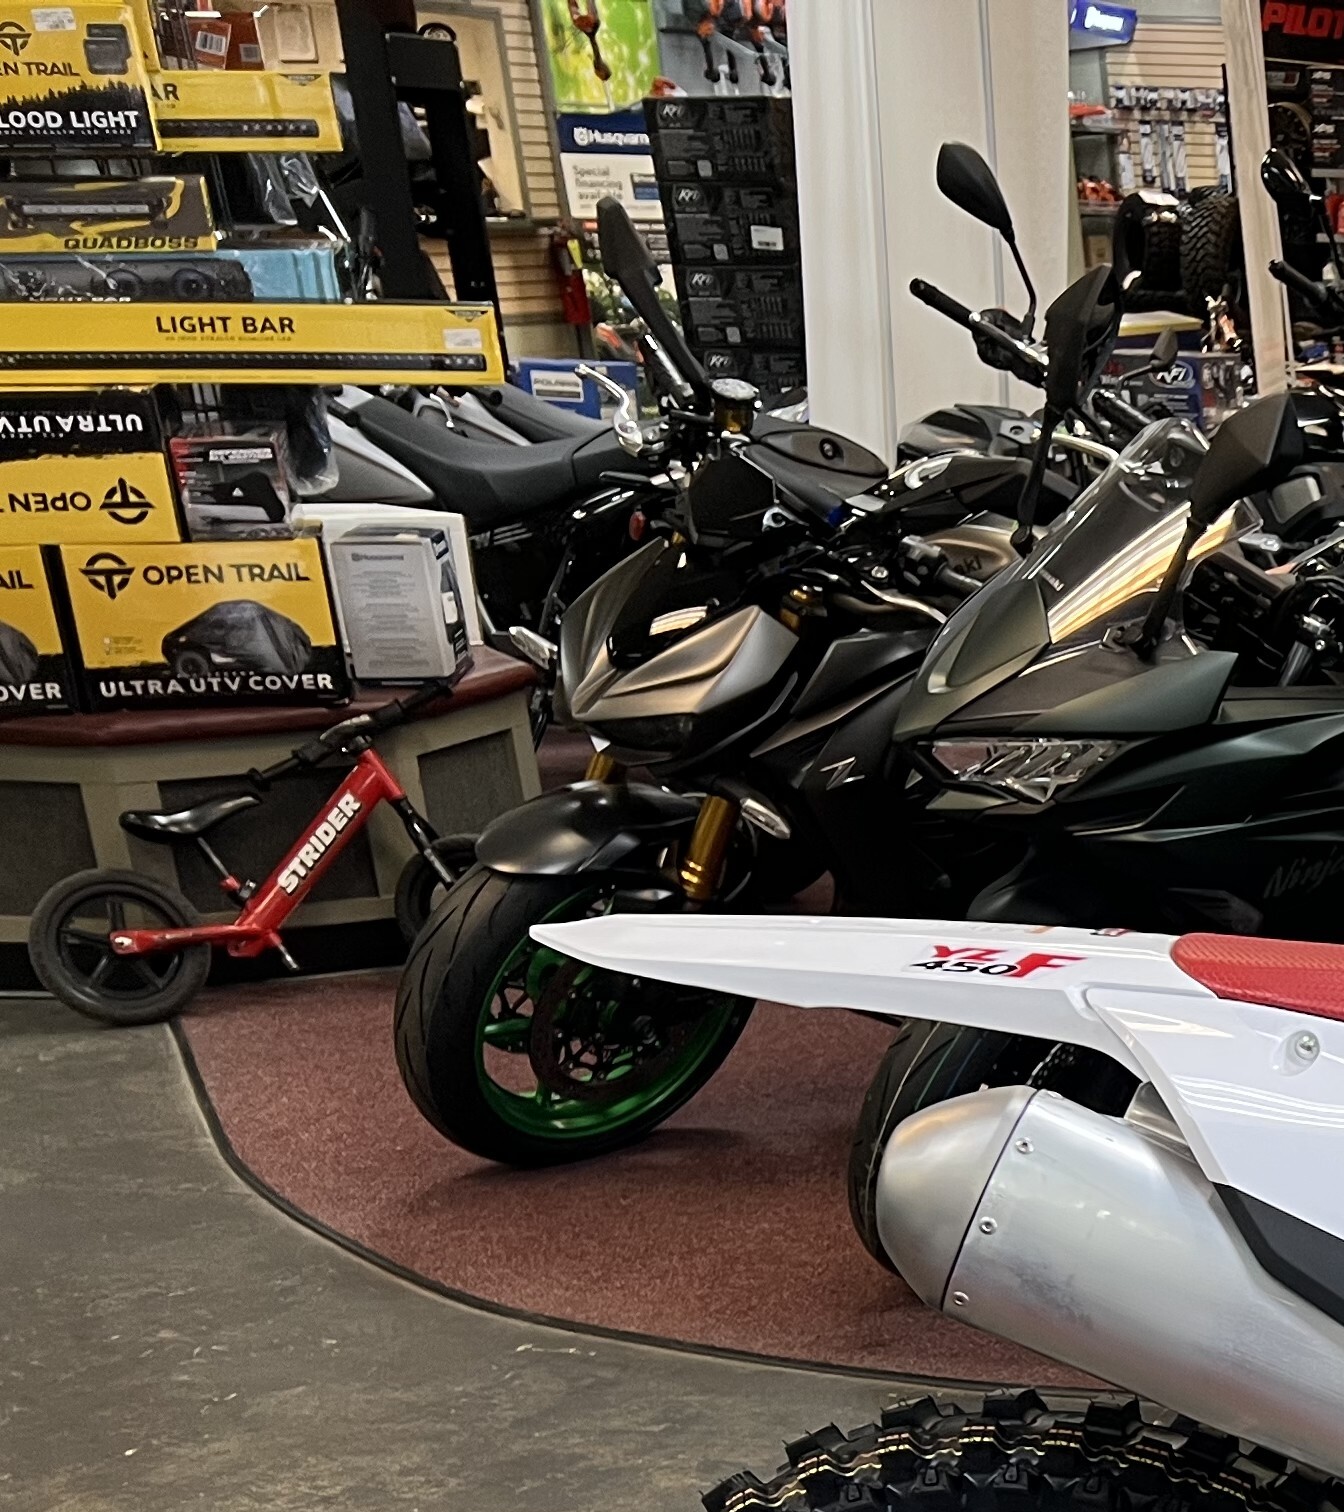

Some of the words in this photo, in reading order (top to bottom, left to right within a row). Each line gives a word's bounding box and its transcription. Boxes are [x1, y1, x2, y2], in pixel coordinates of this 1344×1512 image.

[22, 62, 80, 76] TRAIL
[151, 83, 179, 101] AR
[0, 111, 63, 129] LOOD
[70, 111, 138, 128] LIGHT
[65, 236, 198, 249] QUADBOSS
[156, 316, 231, 333] LIGHT
[241, 316, 295, 334] BAR
[0, 415, 50, 433] UTV
[56, 414, 143, 432] ULTRA
[8, 491, 92, 512] OPEN
[0, 570, 34, 590] AIL
[143, 564, 224, 586] OPEN
[229, 562, 311, 583] TRAIL
[0, 682, 62, 701] OVER
[100, 679, 185, 698] ULTRA
[189, 677, 240, 693] UTV
[249, 673, 333, 690] COVER
[276, 790, 362, 895] STRIDER
[933, 944, 1008, 962] YZ
[910, 961, 1018, 977] 450
